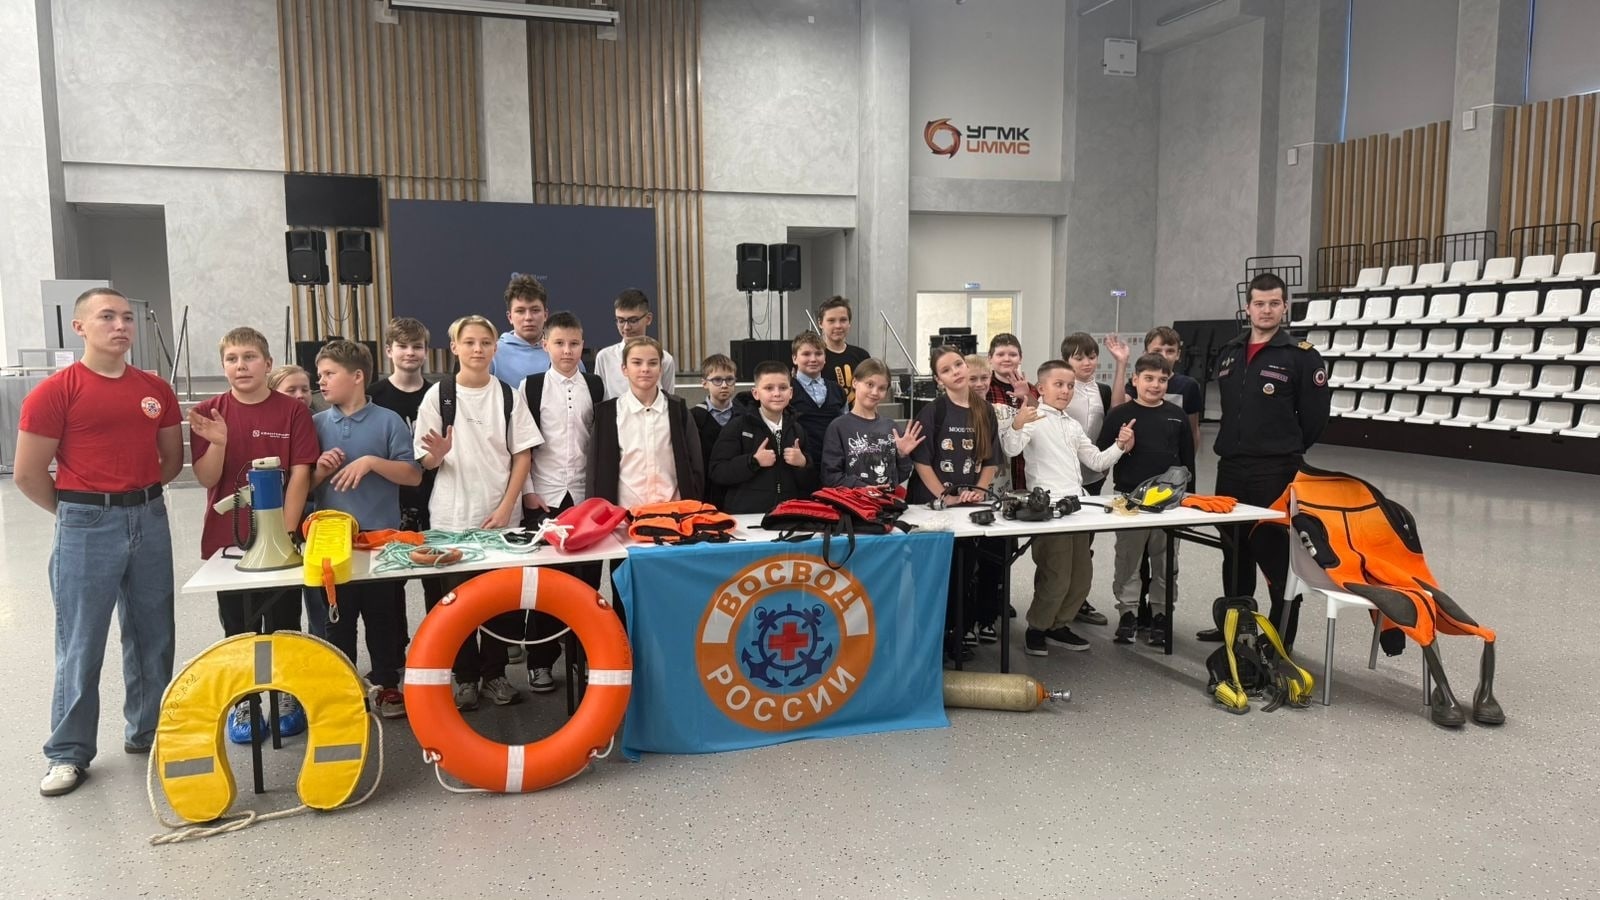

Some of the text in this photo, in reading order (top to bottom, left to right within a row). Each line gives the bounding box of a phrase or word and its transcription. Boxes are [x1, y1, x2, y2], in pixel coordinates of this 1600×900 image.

[966, 125, 1030, 141] УГМК
[966, 140, 1030, 155] UMMC
[716, 561, 860, 618] ВОСВОД
[706, 664, 857, 722] РОССИИ
